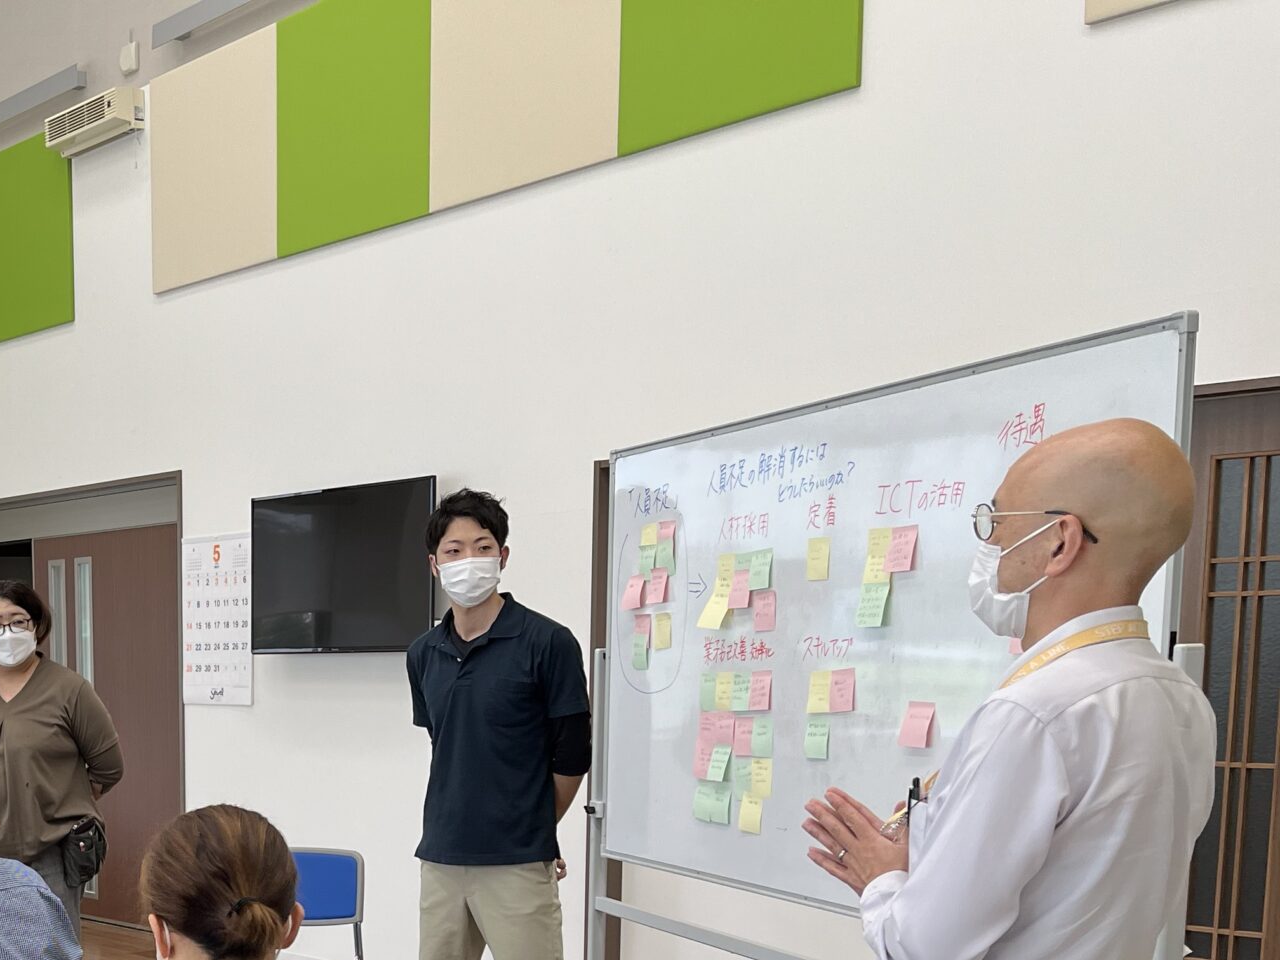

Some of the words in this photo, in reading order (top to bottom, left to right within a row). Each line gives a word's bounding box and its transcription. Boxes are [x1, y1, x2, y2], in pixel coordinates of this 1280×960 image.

[998, 402, 1045, 451] 待遇
[707, 443, 828, 497] 人員不足の解消するには
[806, 494, 837, 531] 定着
[875, 479, 966, 519] ICTの活用
[718, 512, 769, 543] 人材採用
[213, 543, 221, 563] 5
[213, 599, 220, 607] 10
[223, 599, 229, 607] 11
[232, 598, 239, 606] 12
[241, 597, 248, 606] 13
[195, 621, 202, 630] 15
[204, 621, 211, 630] 16
[213, 620, 220, 629] 17
[223, 620, 229, 629] 18
[232, 620, 239, 628] 19
[241, 620, 248, 628] 20
[195, 643, 202, 651] 22
[204, 643, 211, 651] 23
[213, 643, 220, 651] 24
[223, 642, 229, 651] 25
[232, 642, 239, 650] 26
[241, 642, 248, 650] 27
[803, 635, 853, 663] スキルアップ
[195, 664, 202, 672] 29
[204, 664, 211, 672] 30
[213, 664, 220, 672] 31
